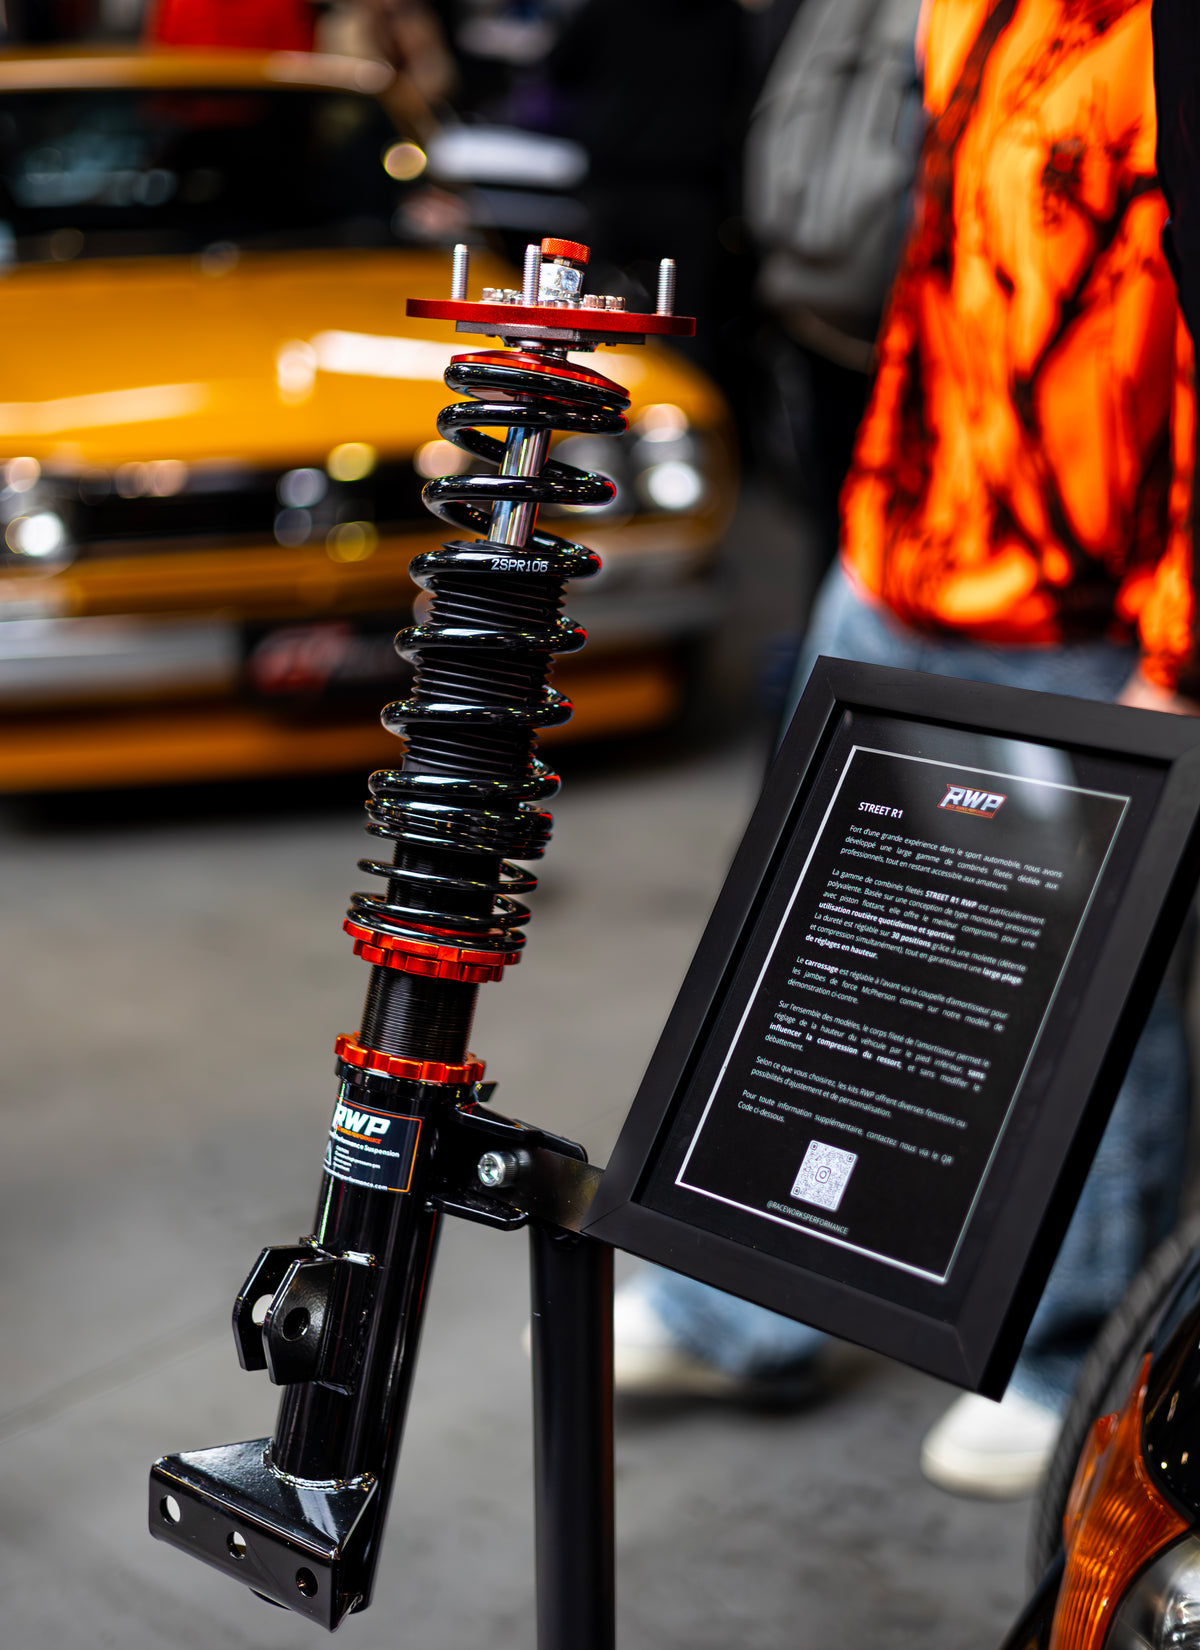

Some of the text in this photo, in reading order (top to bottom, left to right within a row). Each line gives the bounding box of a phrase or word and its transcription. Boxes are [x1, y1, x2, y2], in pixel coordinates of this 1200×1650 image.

[858, 801, 904, 819] STREET R1
[940, 786, 1005, 811] RWP
[844, 836, 876, 849] développé
[879, 844, 893, 853] une
[896, 847, 912, 858] large
[915, 852, 940, 863] gamme
[943, 858, 954, 866] de
[849, 824, 983, 860] Fort d'une grande expérience dans le sport
[839, 847, 884, 863] professionnels,
[885, 857, 900, 866] tout
[907, 863, 931, 873] restant
[930, 868, 963, 881] accessible
[962, 875, 976, 884] aux
[826, 880, 1004, 928] polyvalente. Basée sur une conception de type monotube
[831, 868, 841, 876] La
[839, 871, 864, 882] gamme
[864, 876, 874, 884] de
[873, 879, 904, 891] combinés
[904, 885, 924, 896] filetés
[925, 890, 950, 901] STREET
[949, 895, 960, 904] R1
[960, 898, 978, 908] RWP
[977, 903, 989, 912] est
[818, 902, 955, 941] utilisation routière quotidienne et sportive.
[822, 891, 998, 940] avec piston flottant, elle offre le meilleur compromis
[804, 934, 878, 959] de réglages en hauteur.
[809, 923, 818, 931] et
[816, 925, 855, 940] compression
[904, 948, 919, 958] tout
[918, 952, 928, 960] en
[927, 955, 968, 970] garantissant
[981, 967, 1001, 980] large
[1000, 974, 1023, 986] plage
[813, 912, 823, 920] La
[822, 914, 843, 925] dureté
[843, 920, 854, 928] est
[854, 923, 879, 934] réglable
[879, 929, 890, 937] sur
[891, 931, 901, 940] 30
[899, 935, 931, 948] positions
[931, 943, 950, 953] grâce
[950, 946, 957, 954] à
[956, 949, 971, 958] une
[971, 952, 997, 965] molette
[787, 978, 858, 1004] démonstration ci-contre.
[791, 966, 961, 1020] les jambes de force McPherson comme sur notre
[796, 955, 990, 1014] Le carrossage est réglable à l'avant via la coupelle d'amortisseur
[778, 999, 790, 1009] Sur
[789, 1003, 822, 1019] l'ensemble
[821, 1012, 834, 1022] des
[862, 1024, 870, 1033] le
[869, 1027, 888, 1038] corps
[904, 1037, 915, 1046] de
[769, 1022, 981, 1092] influencer la compression du ressort, et le
[773, 1011, 986, 1080] réglage de la hauteur du véhicule par le sans
[750, 1068, 784, 1084] possibilités
[783, 1078, 823, 1096] d'ajustement
[822, 1091, 830, 1099] et
[829, 1092, 839, 1102] de
[755, 1055, 898, 1107] Selon ce que vous choisirez, les kits RWP offrent
[332, 1103, 391, 1136] RWP
[737, 1100, 785, 1123] Code ci-dessous.
[742, 1089, 757, 1100] Pour
[758, 1095, 776, 1107] toute
[777, 1101, 813, 1118] information
[866, 1131, 898, 1147] contactez
[899, 1141, 917, 1153] nous
[363, 1144, 400, 1159] Suspension
[766, 1200, 849, 1235] @RACEWORKSPERFORMANCE
